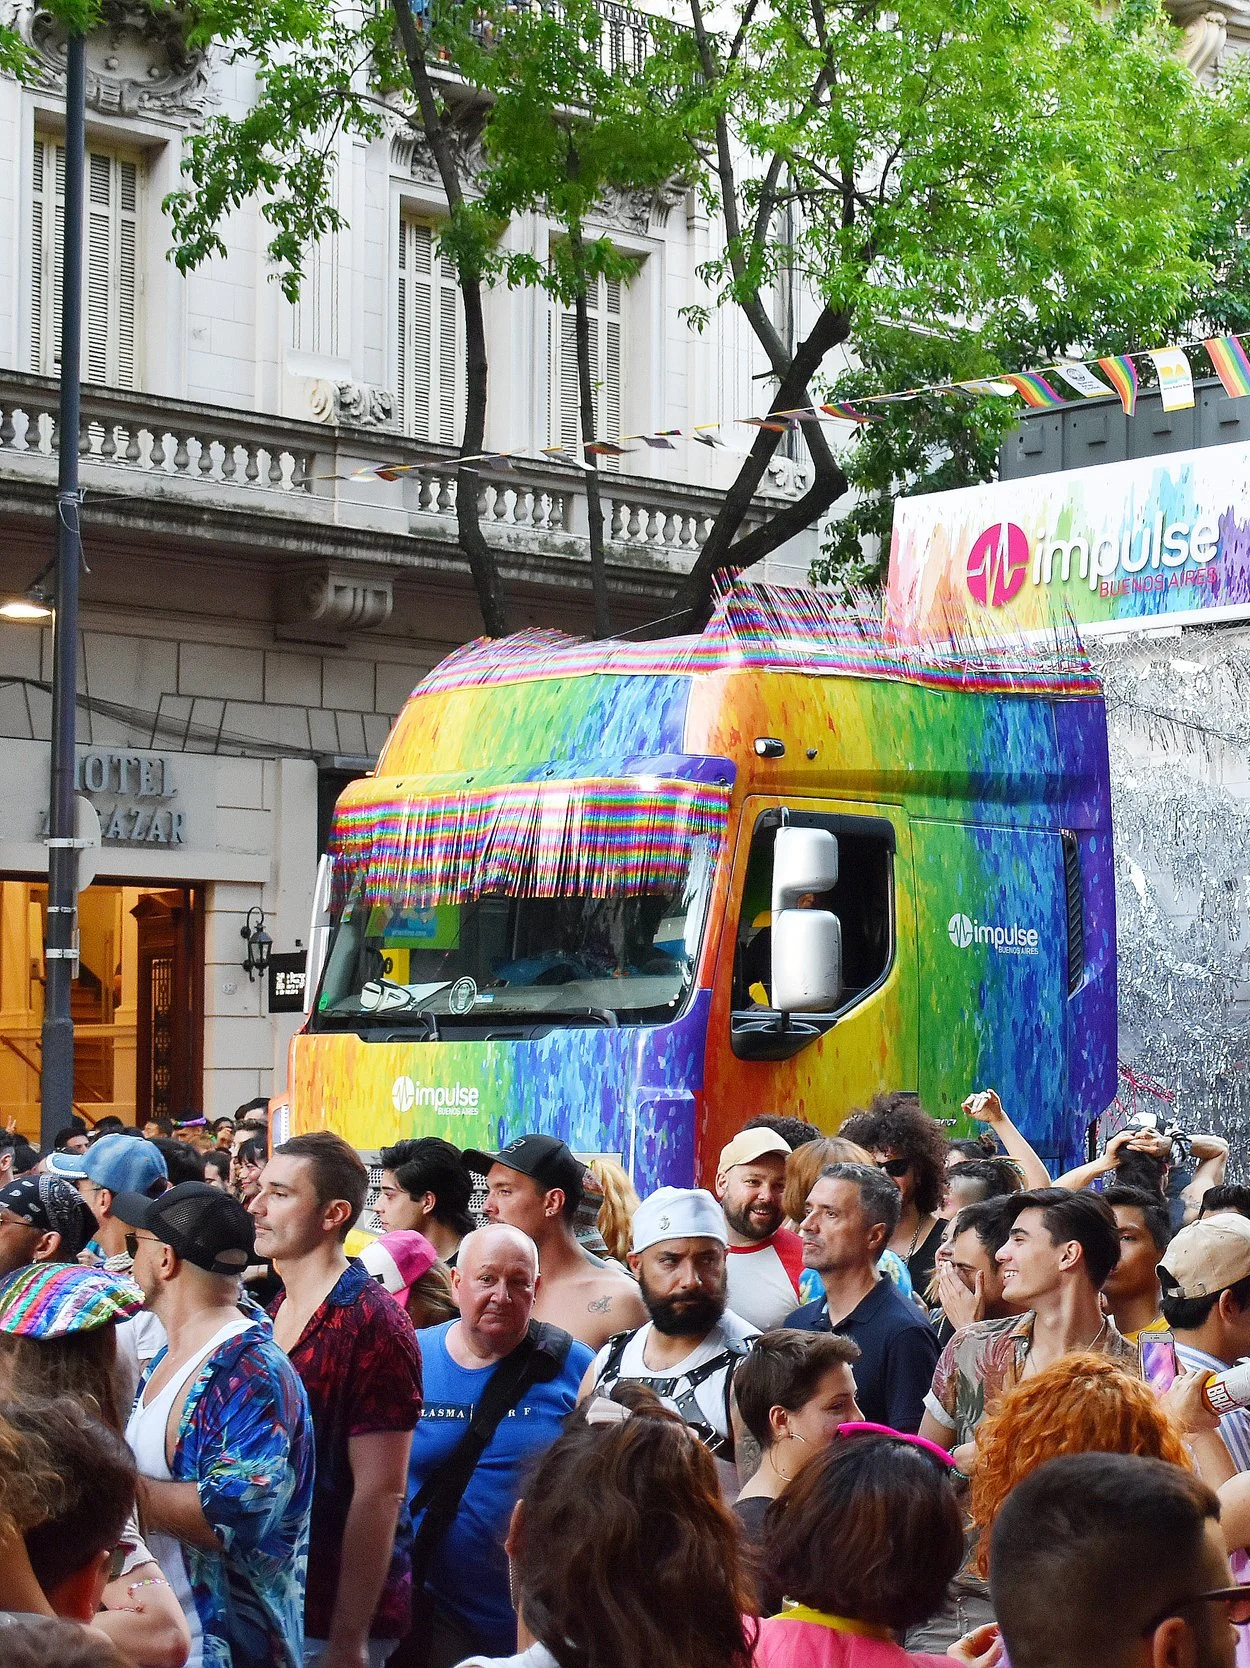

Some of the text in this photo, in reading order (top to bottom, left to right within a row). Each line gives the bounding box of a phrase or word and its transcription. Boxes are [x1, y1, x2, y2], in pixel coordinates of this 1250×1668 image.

[1032, 510, 1222, 592] impulse
[1100, 566, 1218, 598] BUENOS AIRES
[974, 919, 1038, 950] impulse
[998, 945, 1039, 955] BUENOS AIRES
[415, 1080, 480, 1112] impulse
[437, 1106, 479, 1115] BUENOS AIRES
[418, 1408, 465, 1418] LASMA
